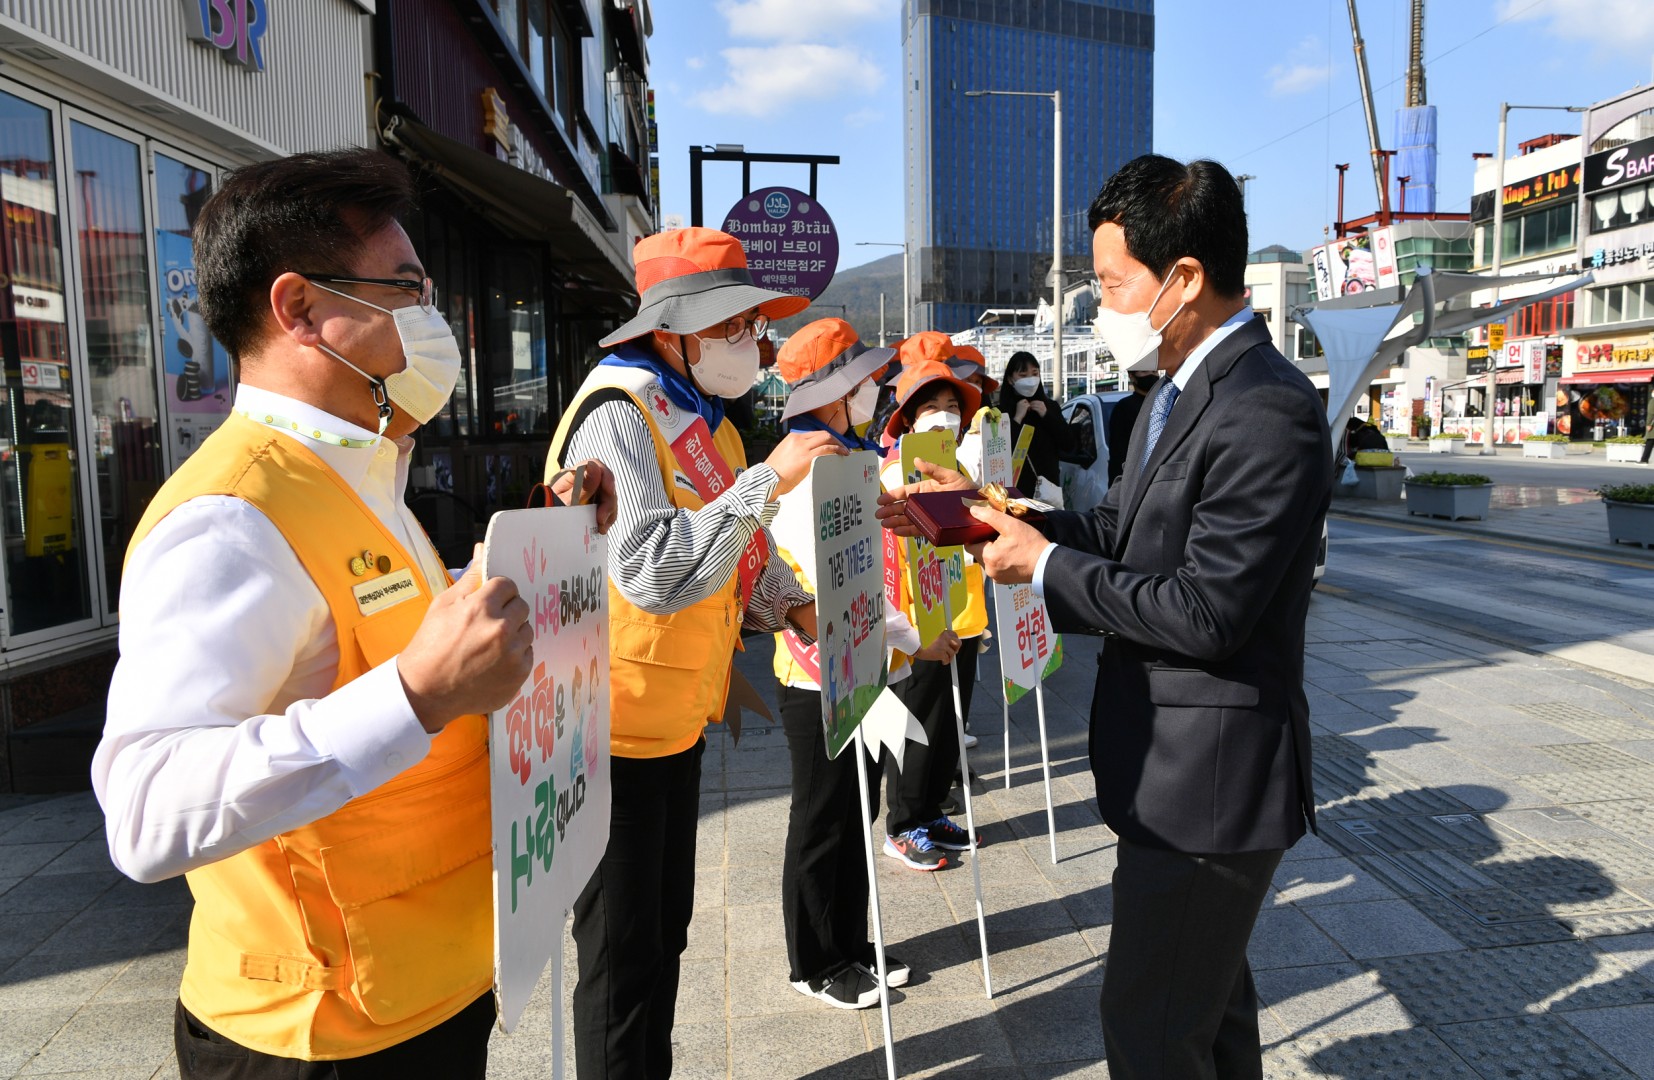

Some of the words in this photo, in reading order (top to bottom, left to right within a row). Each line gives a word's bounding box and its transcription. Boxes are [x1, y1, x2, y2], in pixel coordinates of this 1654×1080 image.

[1502, 185, 1530, 205] Kings
[1547, 170, 1569, 192] Pub
[727, 219, 787, 237] Bombay
[791, 220, 831, 236] Bräu
[781, 240, 821, 254] 브로이
[761, 274, 797, 285] 예약문의
[1508, 345, 1522, 364] 언
[820, 497, 842, 541] 생명을
[842, 492, 863, 533] 살리는
[828, 549, 845, 591] 가장
[844, 539, 865, 580] 가까운
[865, 535, 874, 569] 길
[850, 589, 884, 649] 헌혈입니다
[1015, 604, 1048, 670] 헌혈
[506, 661, 566, 786] 헌혈은
[511, 773, 586, 914] 사랑입니다
